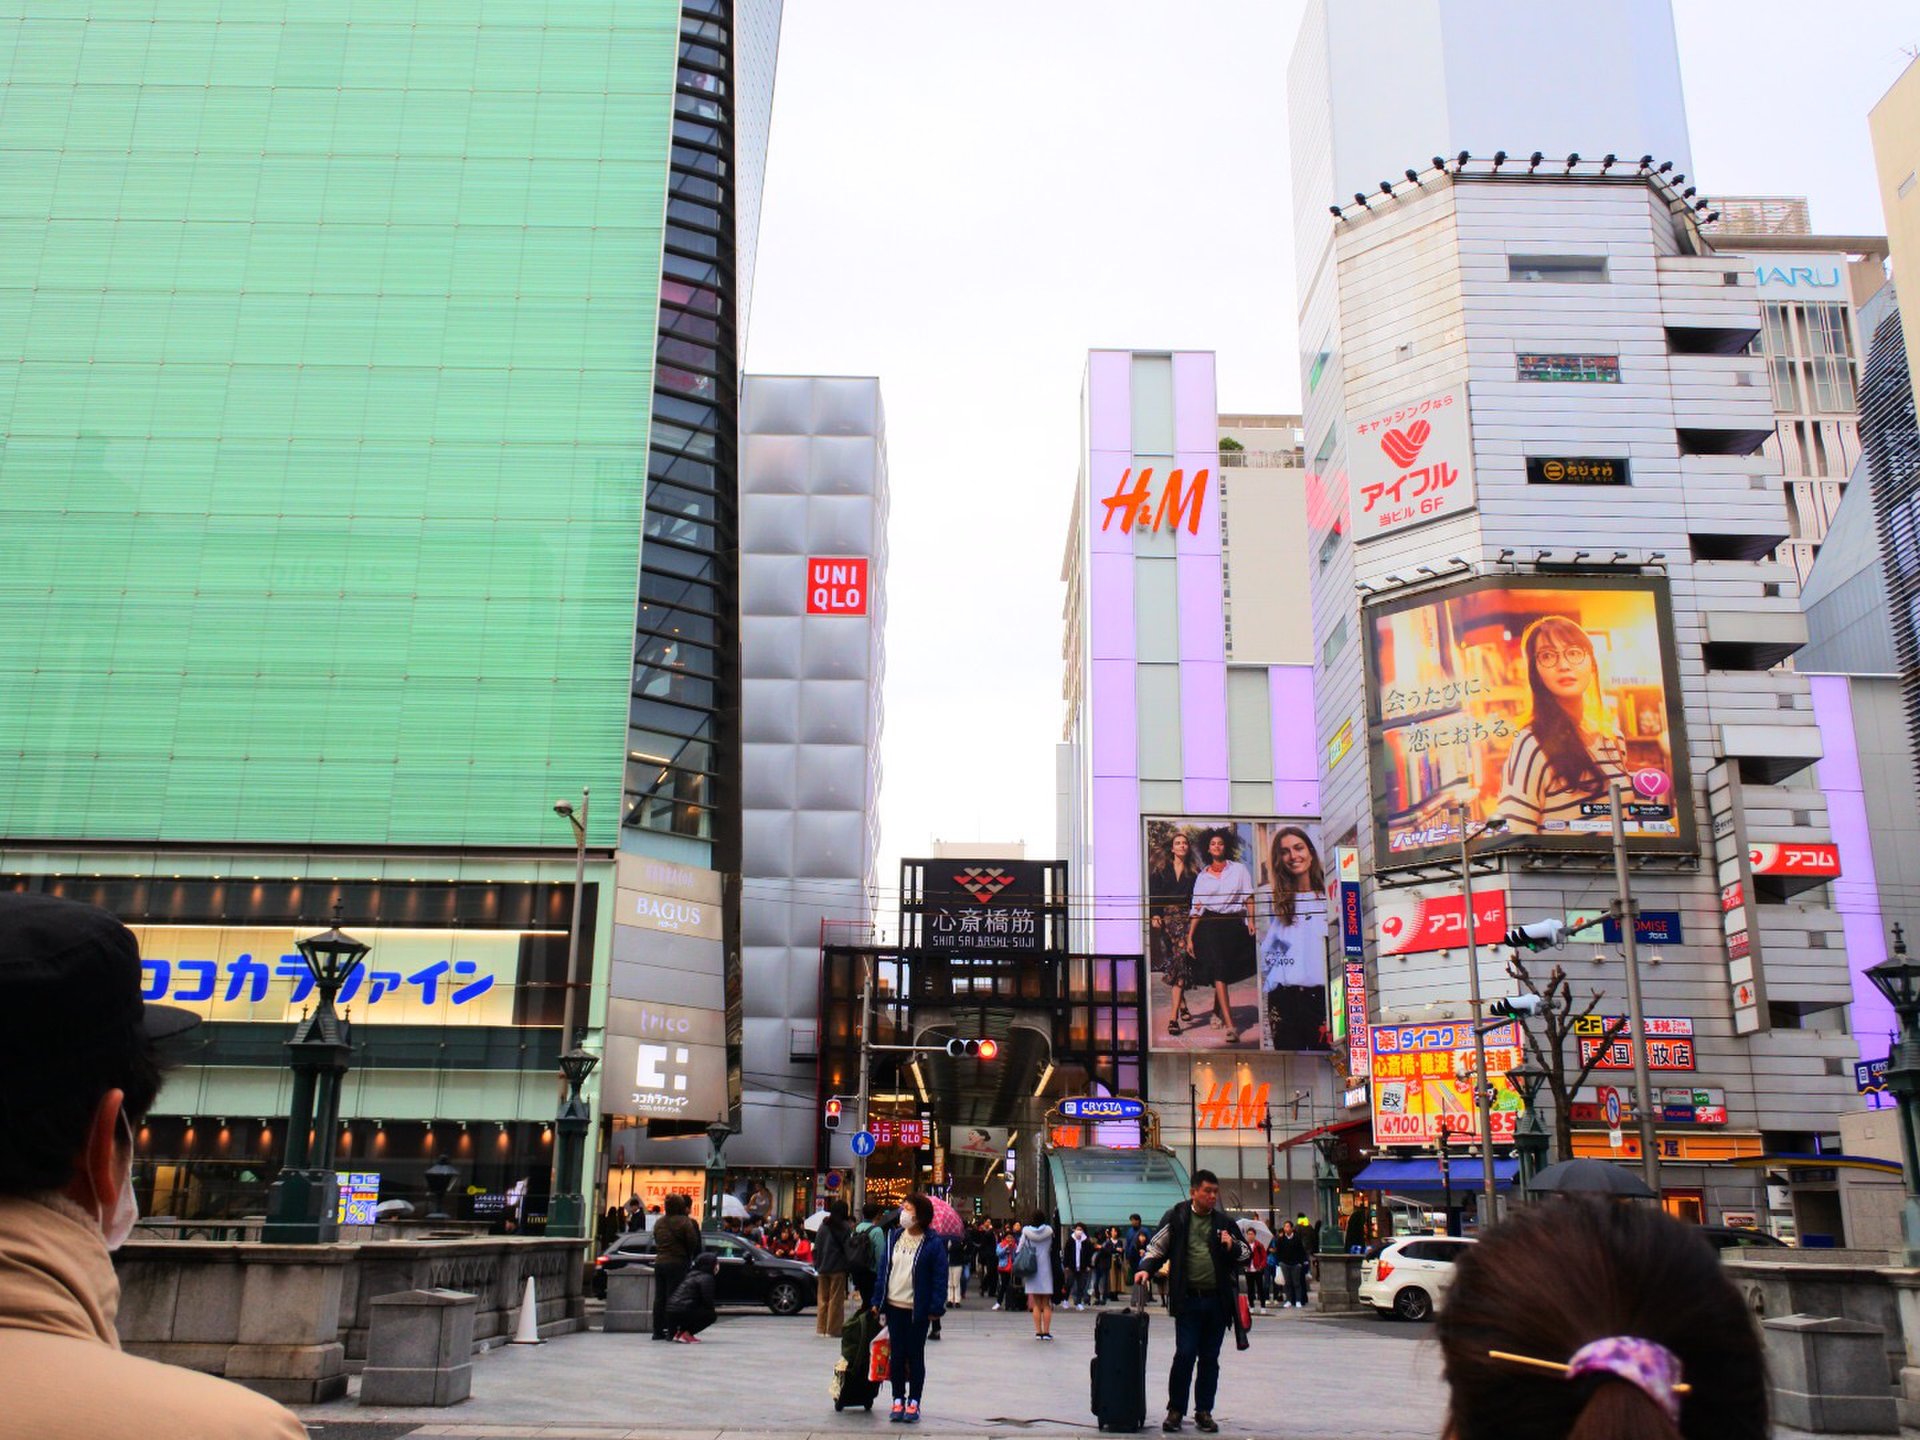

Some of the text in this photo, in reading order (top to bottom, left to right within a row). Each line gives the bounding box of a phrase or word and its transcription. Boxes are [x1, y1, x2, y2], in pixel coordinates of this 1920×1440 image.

[1356, 394, 1454, 435] キャッシングなら
[1360, 461, 1459, 513] アイフル
[1101, 467, 1209, 535] H&M
[1379, 496, 1444, 527] 当ビル 6F
[814, 566, 857, 584] UNI
[813, 588, 860, 608] QLO
[1385, 679, 1491, 713] 会うたびに、
[1408, 719, 1520, 753] 恋におちる。
[1784, 850, 1835, 866] アコム
[636, 898, 701, 925] BAGUS
[932, 908, 1035, 933] 心斎橋筋
[1346, 891, 1358, 936] PROMISE
[1483, 909, 1501, 922] 4F
[1614, 920, 1668, 931] POMISE
[932, 935, 955, 946] SHIN
[640, 1008, 690, 1034] trico
[1578, 1018, 1600, 1032] 2F
[1401, 1027, 1454, 1049] ダイコク
[631, 1093, 689, 1107] ココカラファイン
[1081, 1101, 1122, 1112] CRYSTA
[1198, 1082, 1271, 1132] H&M
[901, 1123, 919, 1133] UNI
[1701, 1114, 1722, 1122] アコム
[901, 1133, 920, 1144] QLO
[647, 1185, 701, 1196] TAX FREE
